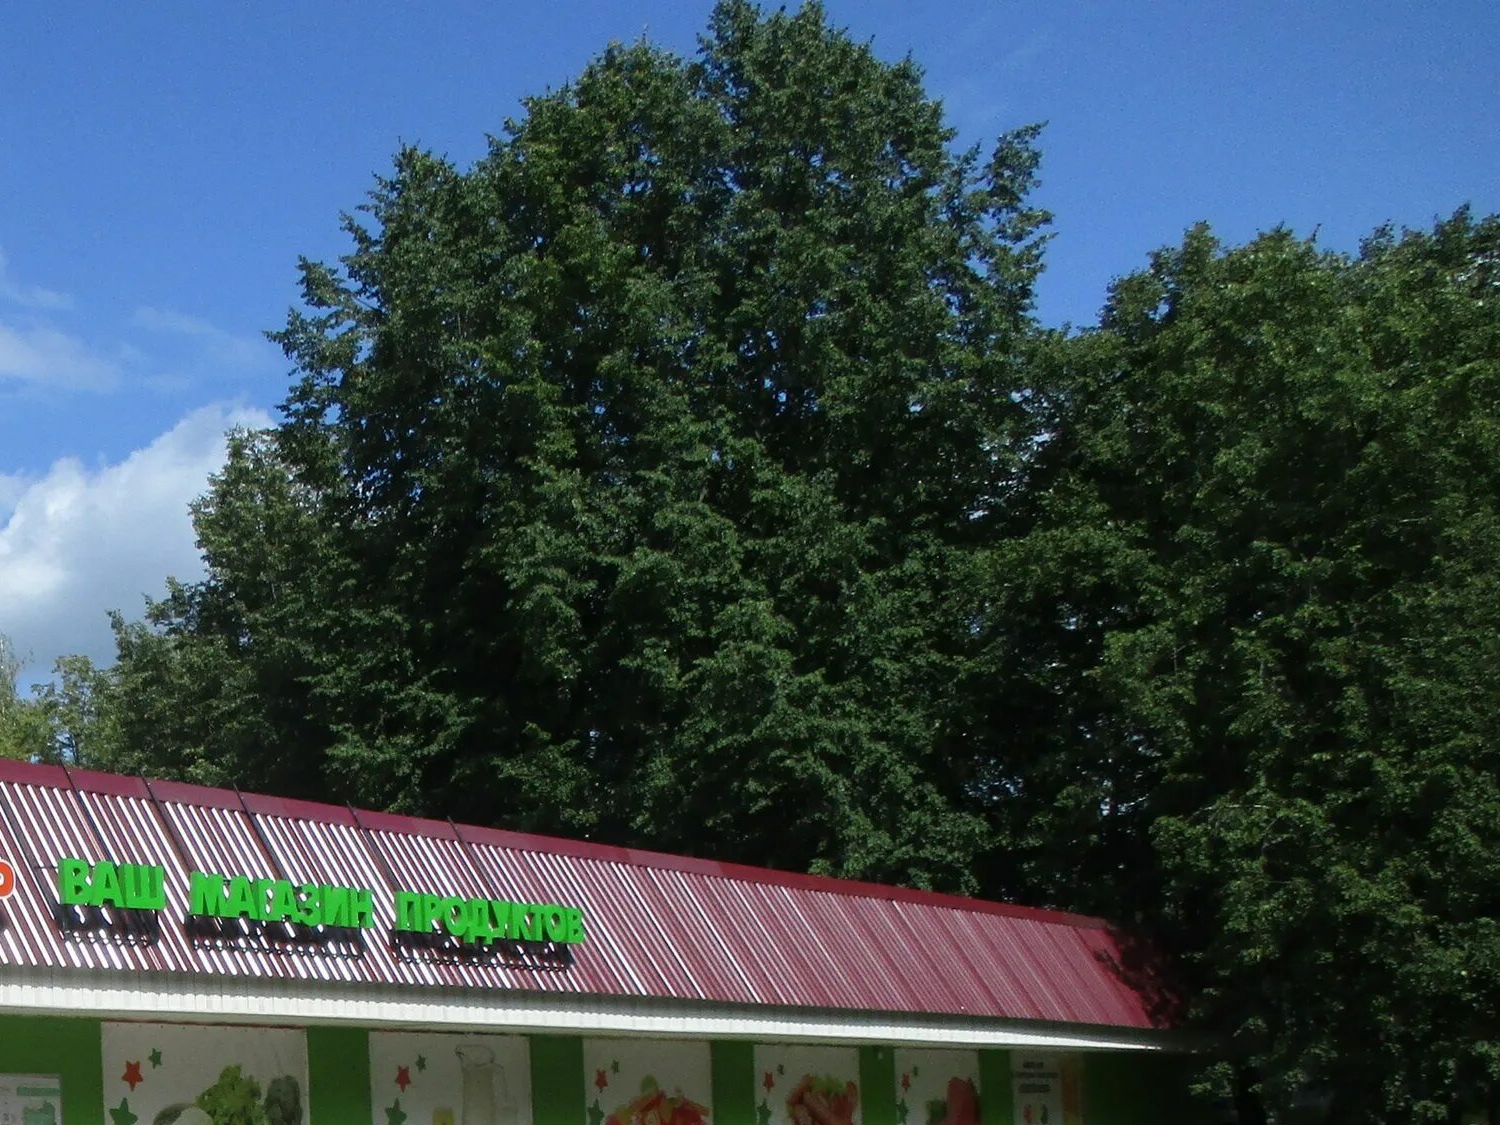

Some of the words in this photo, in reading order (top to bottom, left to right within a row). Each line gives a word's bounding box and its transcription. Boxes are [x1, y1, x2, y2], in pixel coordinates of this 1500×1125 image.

[59, 858, 166, 911] ВАШ
[189, 871, 374, 929] МАГАЗИН
[396, 890, 586, 946] ПРОДУКТОВ
